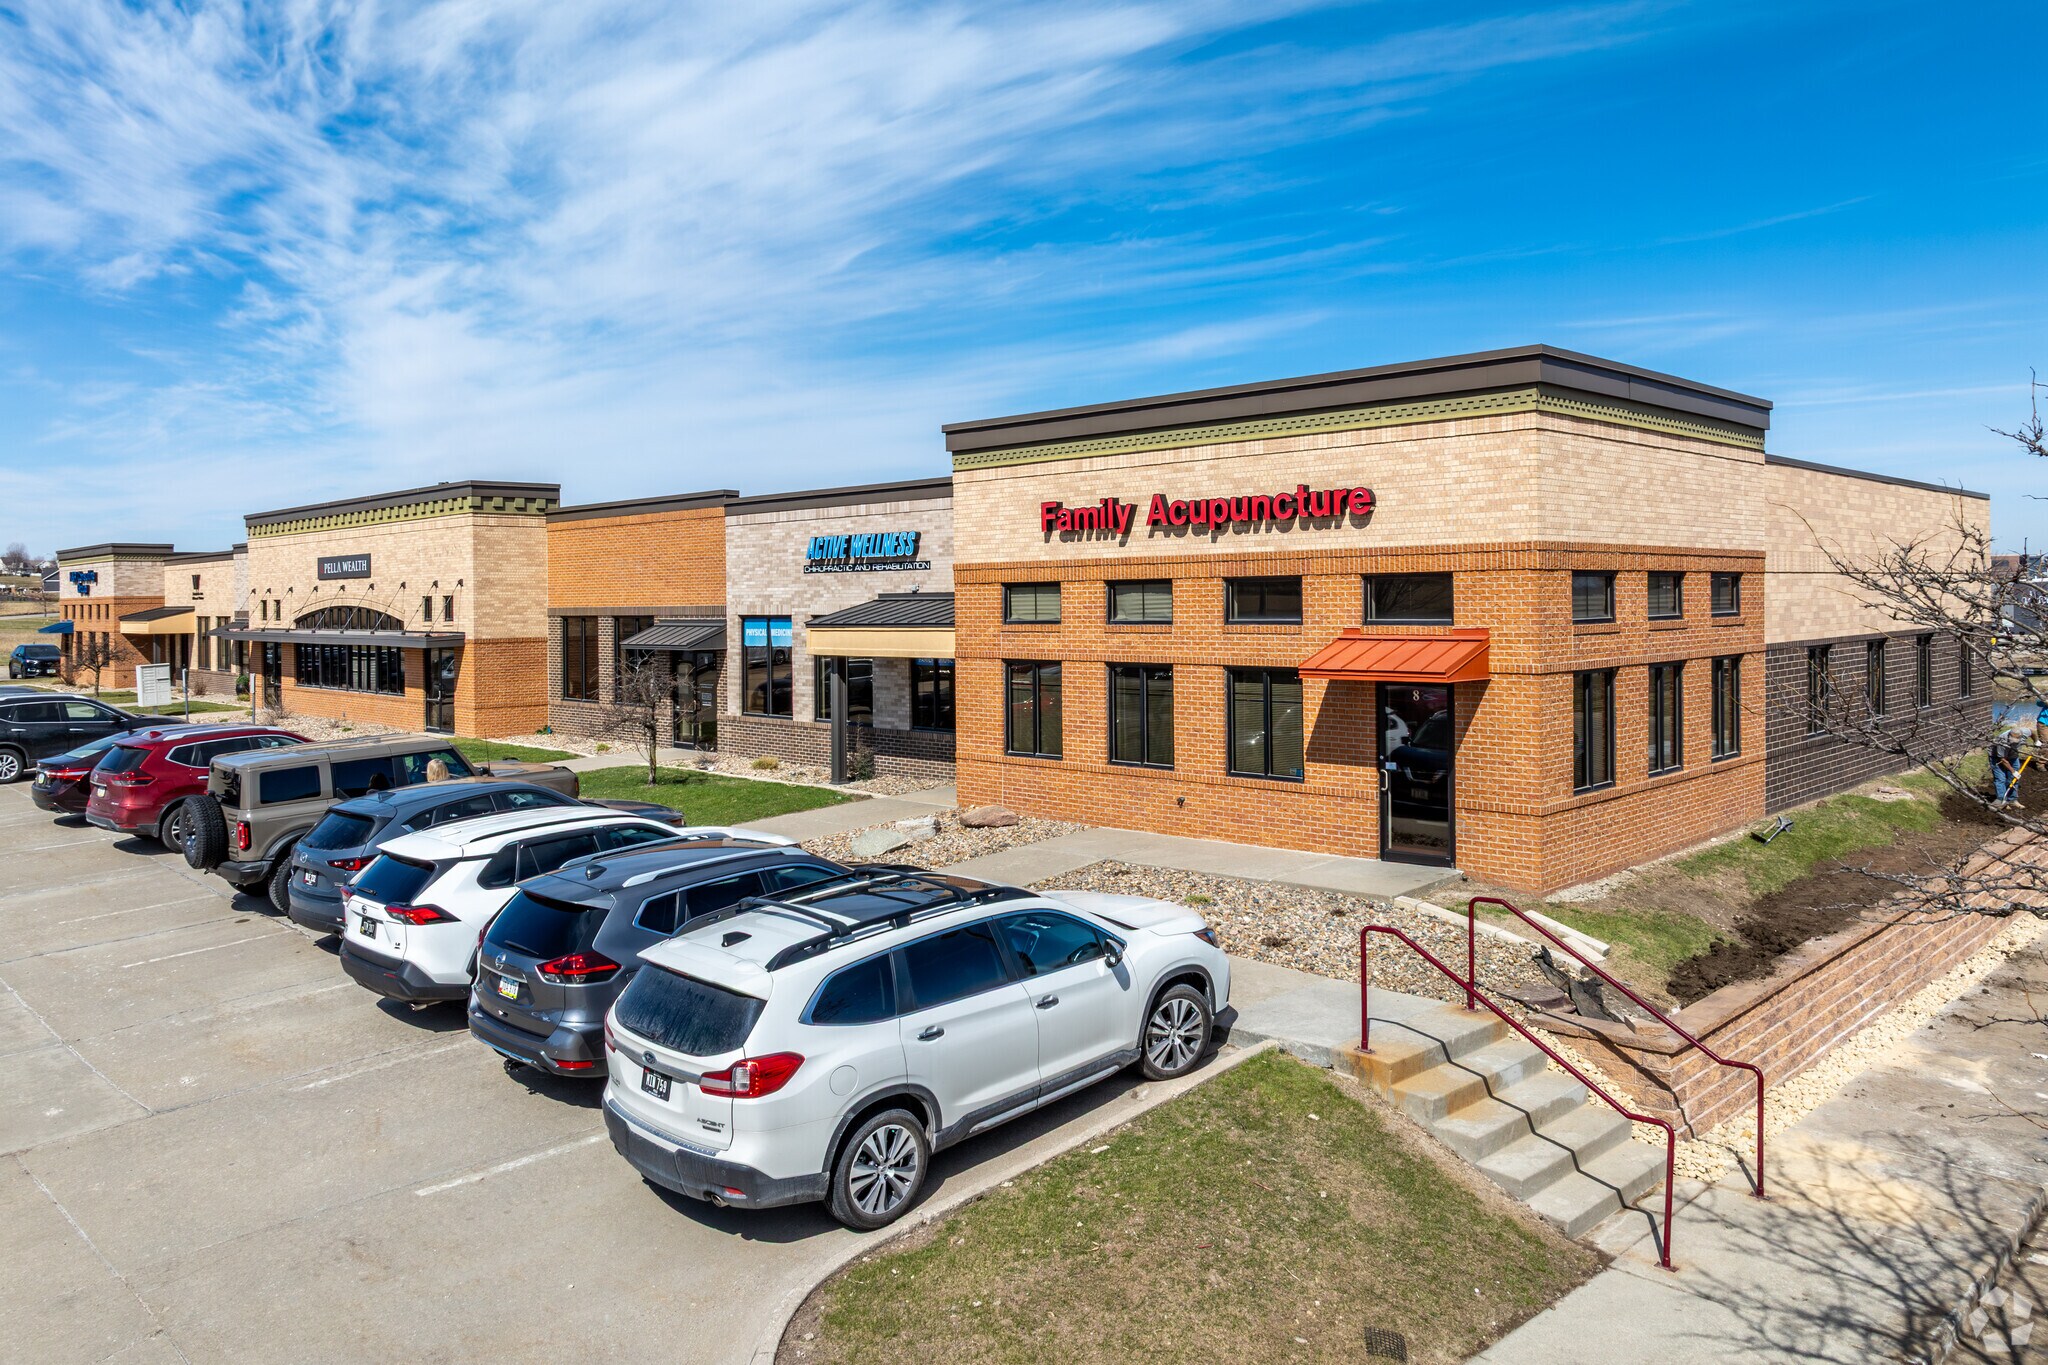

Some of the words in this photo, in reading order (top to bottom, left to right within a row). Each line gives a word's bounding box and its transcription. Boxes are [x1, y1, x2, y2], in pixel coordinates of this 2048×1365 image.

[1041, 498, 1133, 535] Family
[1146, 484, 1373, 531] Acupuncture
[806, 535, 848, 560] ACTIVE
[850, 531, 916, 558] WELLNESS
[324, 561, 342, 574] PELLA
[342, 560, 367, 572] WEALTH
[804, 564, 853, 573] CHIROPRACTIC
[854, 562, 871, 572] AND
[872, 561, 930, 571] REHABILITATION
[1413, 689, 1420, 701] 8
